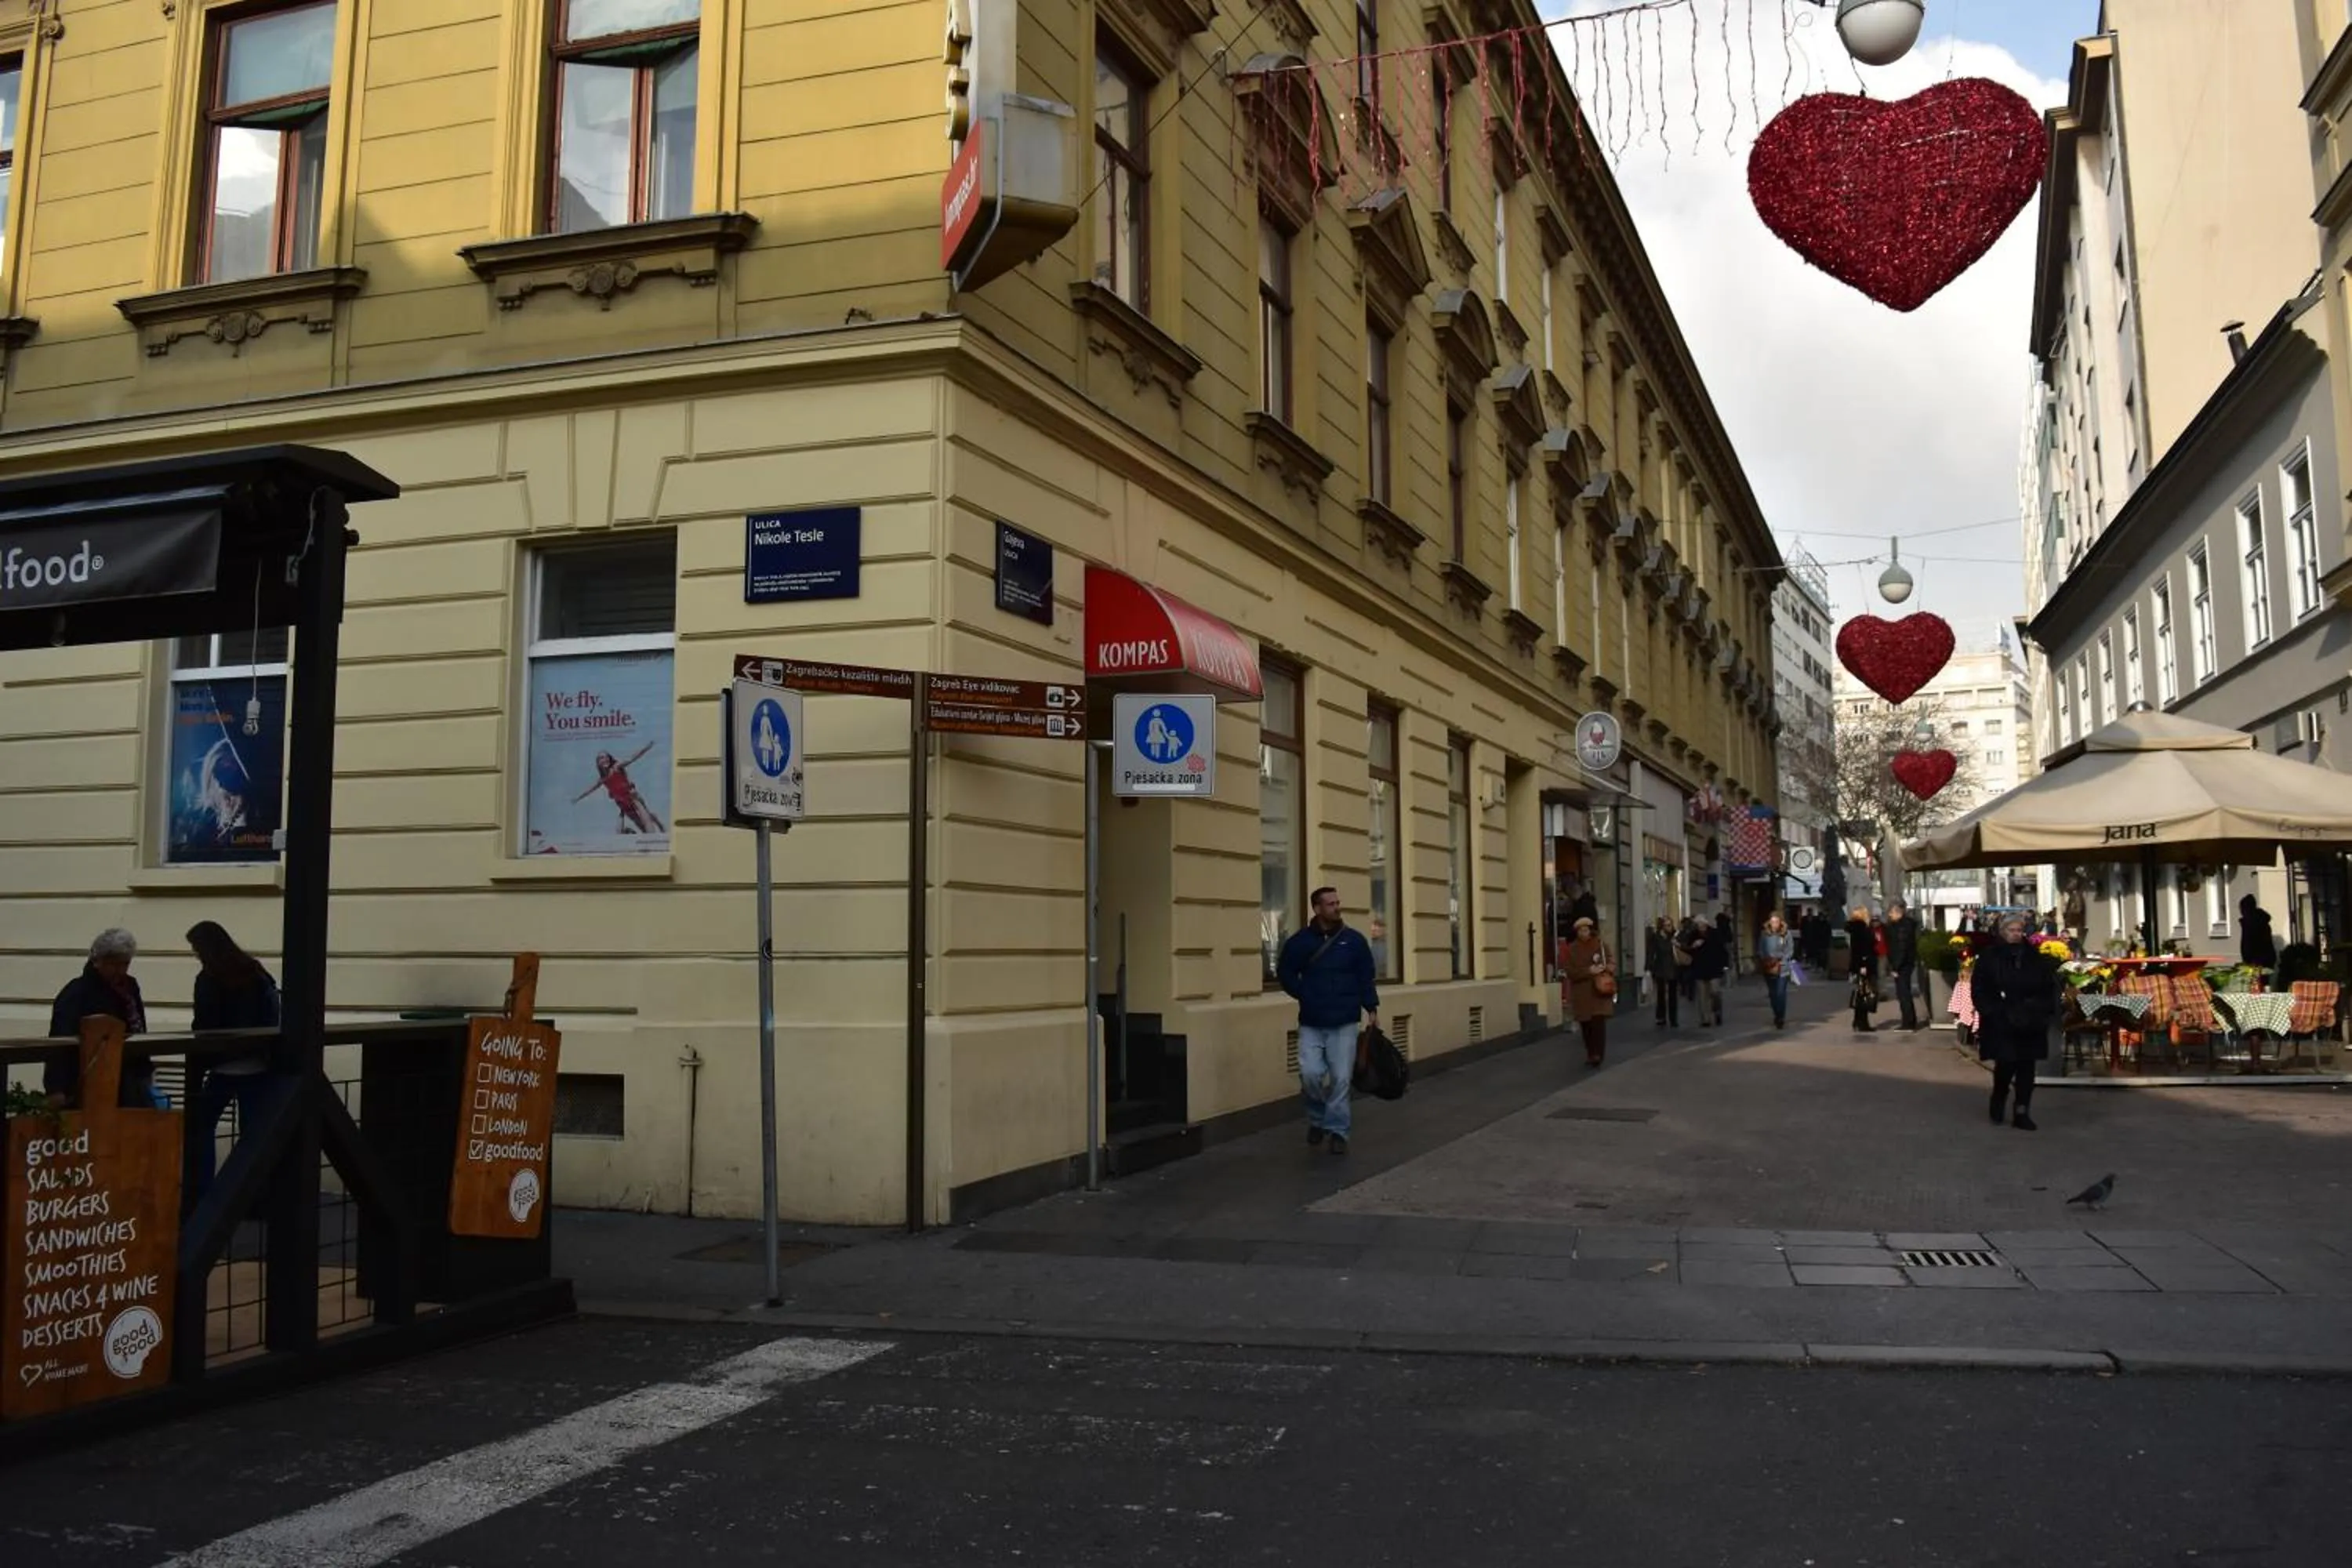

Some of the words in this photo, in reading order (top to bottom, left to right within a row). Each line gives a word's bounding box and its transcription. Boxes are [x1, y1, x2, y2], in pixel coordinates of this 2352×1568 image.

[755, 520, 781, 529] ULICA
[755, 531, 791, 545] Nikole
[794, 528, 824, 543] Tesle
[1099, 640, 1169, 668] KOMPAS
[931, 677, 960, 691] Zagreb
[546, 692, 573, 710] We
[578, 690, 603, 714] fly.
[546, 713, 580, 729] You
[583, 709, 636, 728] smile.
[1178, 773, 1203, 784] zona
[481, 1031, 523, 1060] GOING
[491, 1091, 519, 1112] PARIS
[488, 1116, 528, 1137] LONDON
[27, 1128, 89, 1166] good
[484, 1142, 544, 1163] goodfood
[26, 1191, 110, 1227] BURGERS
[24, 1218, 137, 1257] SANDWICHES
[24, 1248, 127, 1289] SMOOTHIES
[22, 1283, 92, 1319] SNACKS
[112, 1274, 159, 1301] WINE
[22, 1312, 103, 1349] DESSERTS
[113, 1318, 148, 1356] good
[122, 1323, 156, 1363] food
